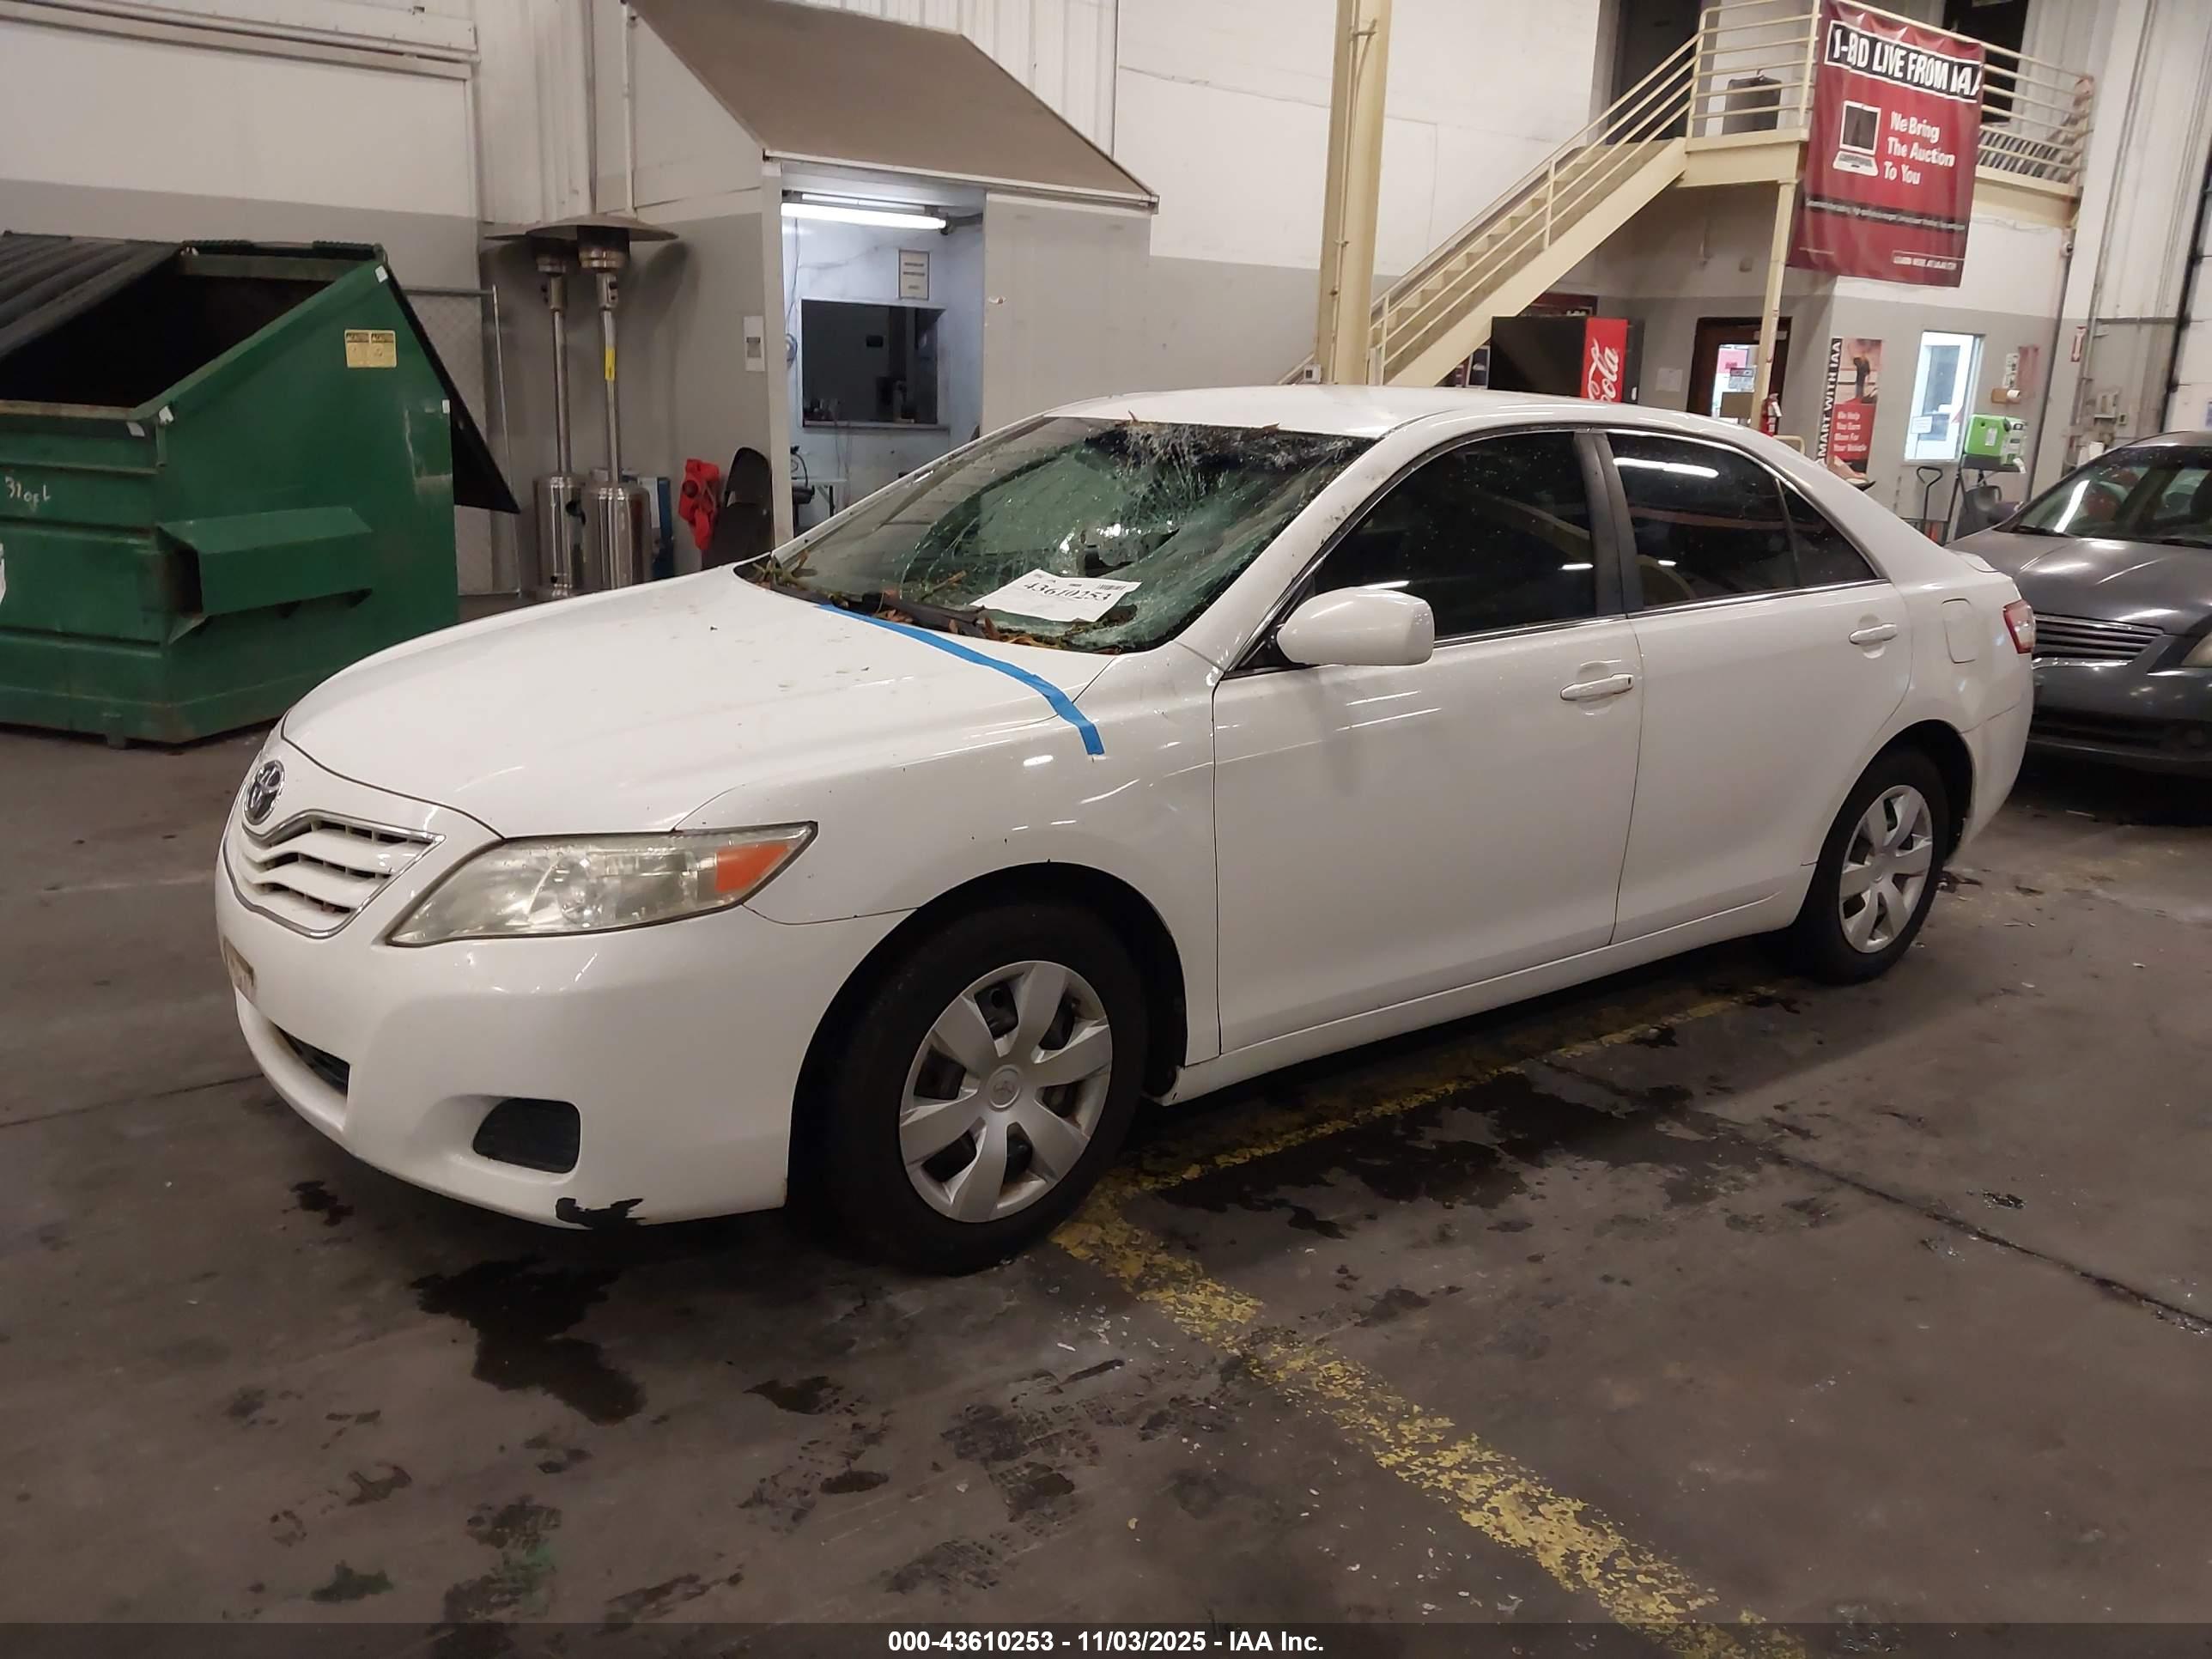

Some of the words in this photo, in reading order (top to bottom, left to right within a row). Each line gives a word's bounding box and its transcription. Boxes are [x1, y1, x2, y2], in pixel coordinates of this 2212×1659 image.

[1872, 41, 1906, 78] LIVE
[1906, 52, 1949, 91] FROM
[1908, 116, 1941, 144] Bring
[1887, 136, 1907, 158] The
[1909, 142, 1956, 167] Auction
[1884, 161, 1898, 181] To
[1901, 163, 1921, 185] You
[1829, 342, 1842, 368] IAA
[1823, 372, 1838, 411] WITH
[1023, 581, 1112, 601] 43610253
